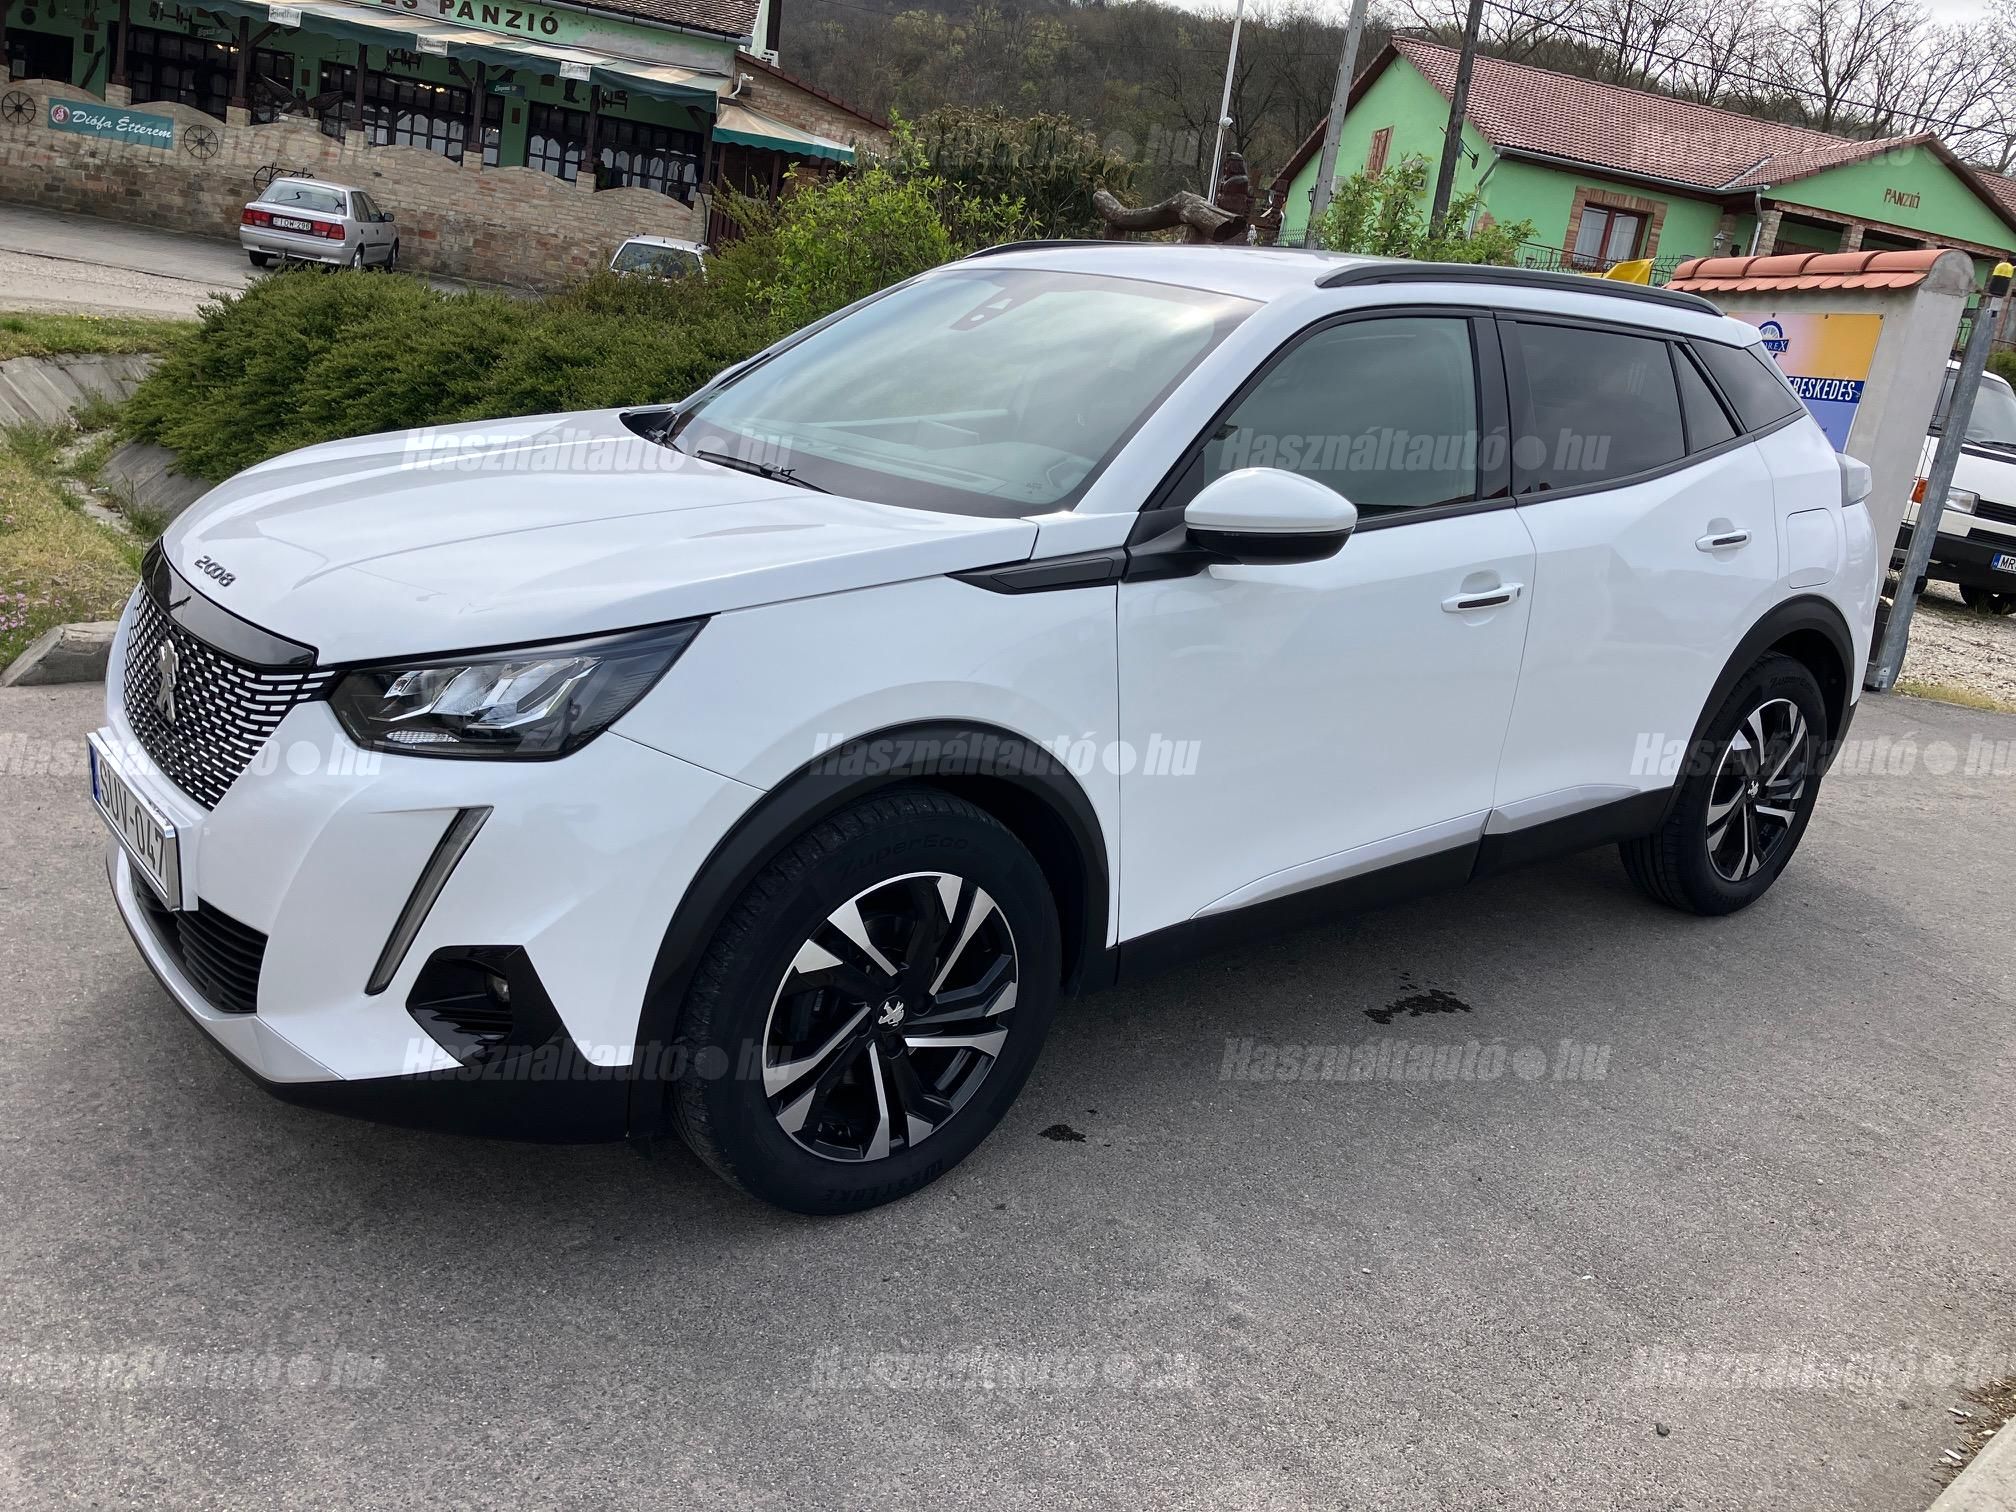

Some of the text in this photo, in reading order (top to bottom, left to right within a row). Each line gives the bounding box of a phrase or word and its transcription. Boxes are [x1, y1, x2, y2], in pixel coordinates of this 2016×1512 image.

[439, 0, 559, 35] PANZIÓ
[72, 111, 172, 138] Diófa Étterem
[1884, 188, 1920, 209] PANZIÓ
[194, 555, 237, 588] 2008
[100, 759, 164, 878] SUV-047
